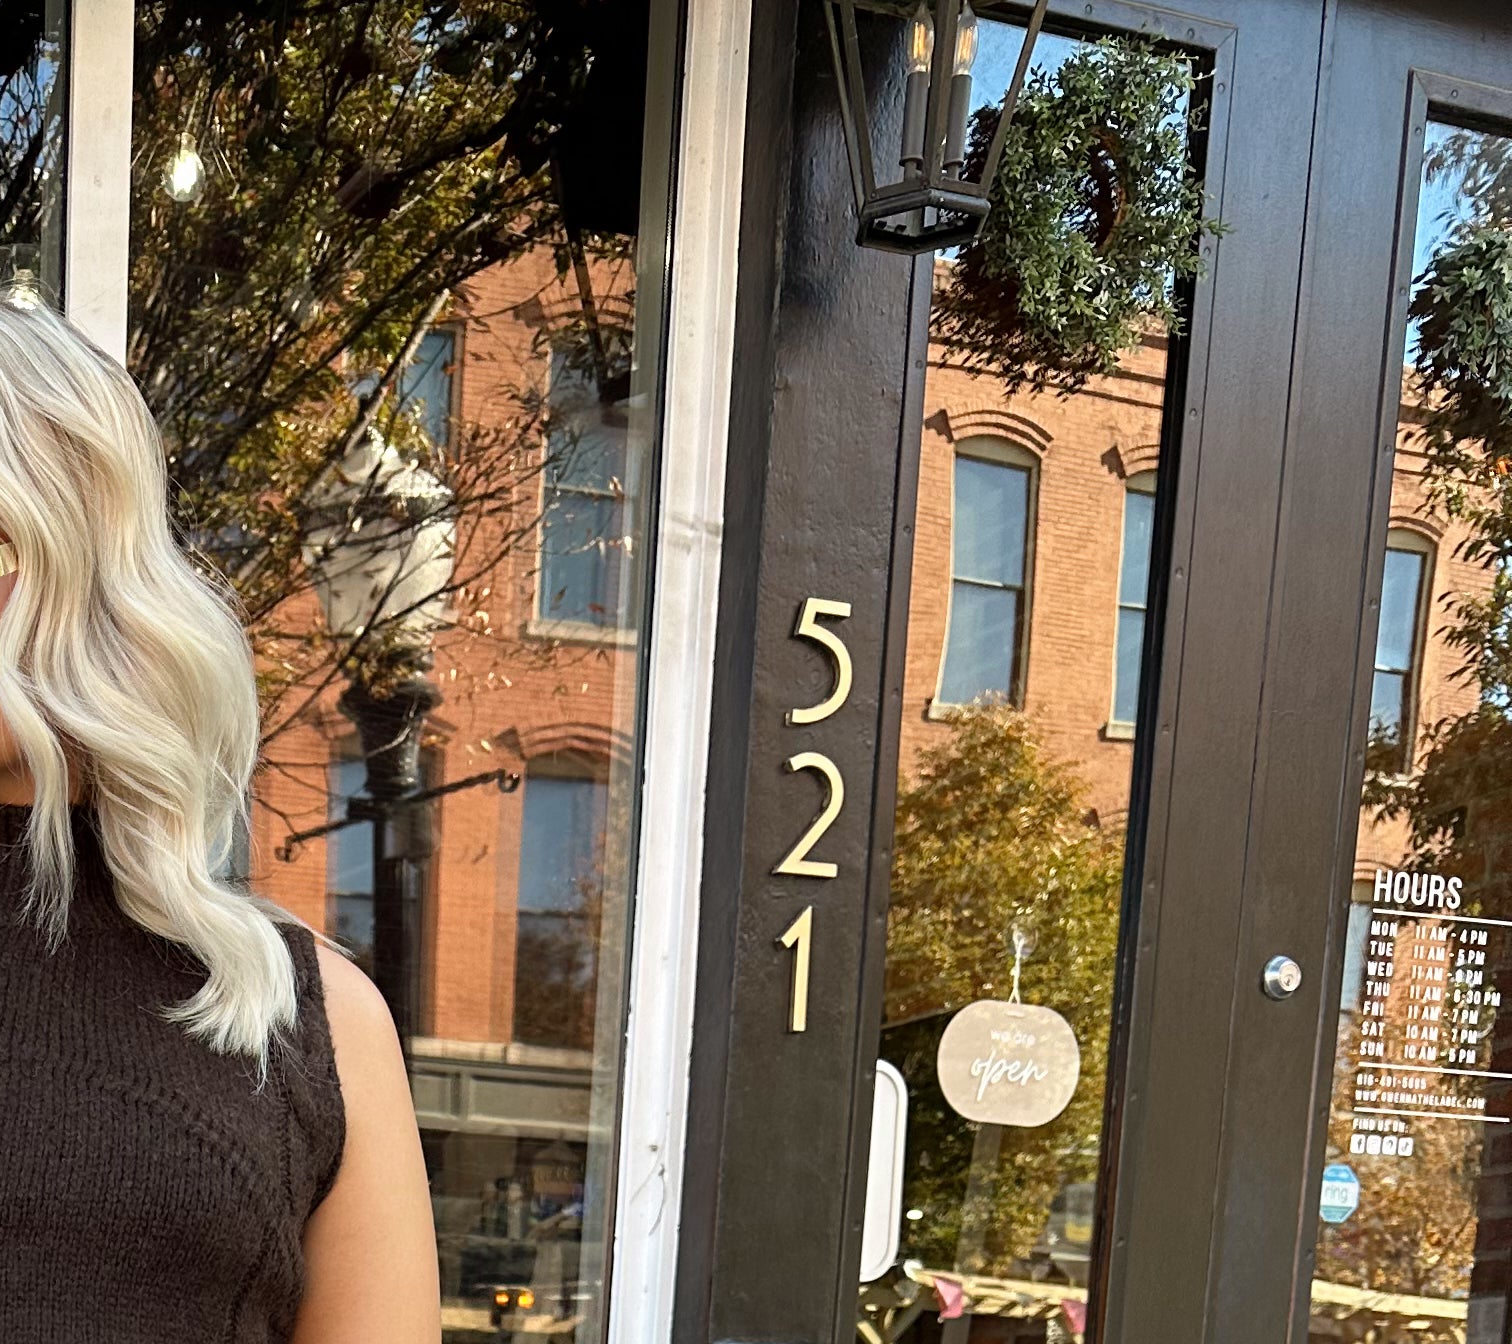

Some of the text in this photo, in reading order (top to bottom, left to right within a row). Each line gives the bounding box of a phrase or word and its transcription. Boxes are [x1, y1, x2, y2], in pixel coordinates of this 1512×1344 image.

[772, 597, 853, 1032] 521
[1374, 868, 1463, 910] HOURS
[1370, 920, 1398, 937] MON
[1416, 925, 1426, 940] 11
[1429, 926, 1448, 942] AM
[1470, 930, 1488, 946] PM
[1370, 940, 1394, 957] TUE
[1414, 945, 1425, 960] 11
[1427, 946, 1445, 962] AM
[1467, 949, 1486, 966] PM
[1368, 960, 1394, 977] WED
[1411, 964, 1422, 979] 11
[1425, 966, 1444, 981] AM
[1465, 969, 1483, 985] PM
[1366, 980, 1390, 997] THU
[1409, 984, 1420, 1000] 11
[1423, 985, 1442, 1001] AM
[1483, 991, 1501, 1007] PM
[1363, 1000, 1384, 1017] FRI
[1408, 1005, 1419, 1019] 11
[1421, 1005, 1441, 1021] AM
[1461, 1009, 1479, 1024] PM
[990, 1029, 1010, 1042] we
[1361, 1020, 1386, 1037] SAT
[1406, 1024, 1418, 1039] 10
[1420, 1026, 1439, 1041] AM
[1460, 1029, 1478, 1044] PM
[1359, 1040, 1385, 1057] SUN
[1404, 1044, 1417, 1059] 10
[1418, 1046, 1437, 1061] AM
[1459, 1048, 1476, 1064] PM
[970, 1048, 1049, 1101] open
[1352, 1117, 1376, 1131] FIND
[1377, 1119, 1391, 1132] US
[1324, 1184, 1348, 1204] ring
